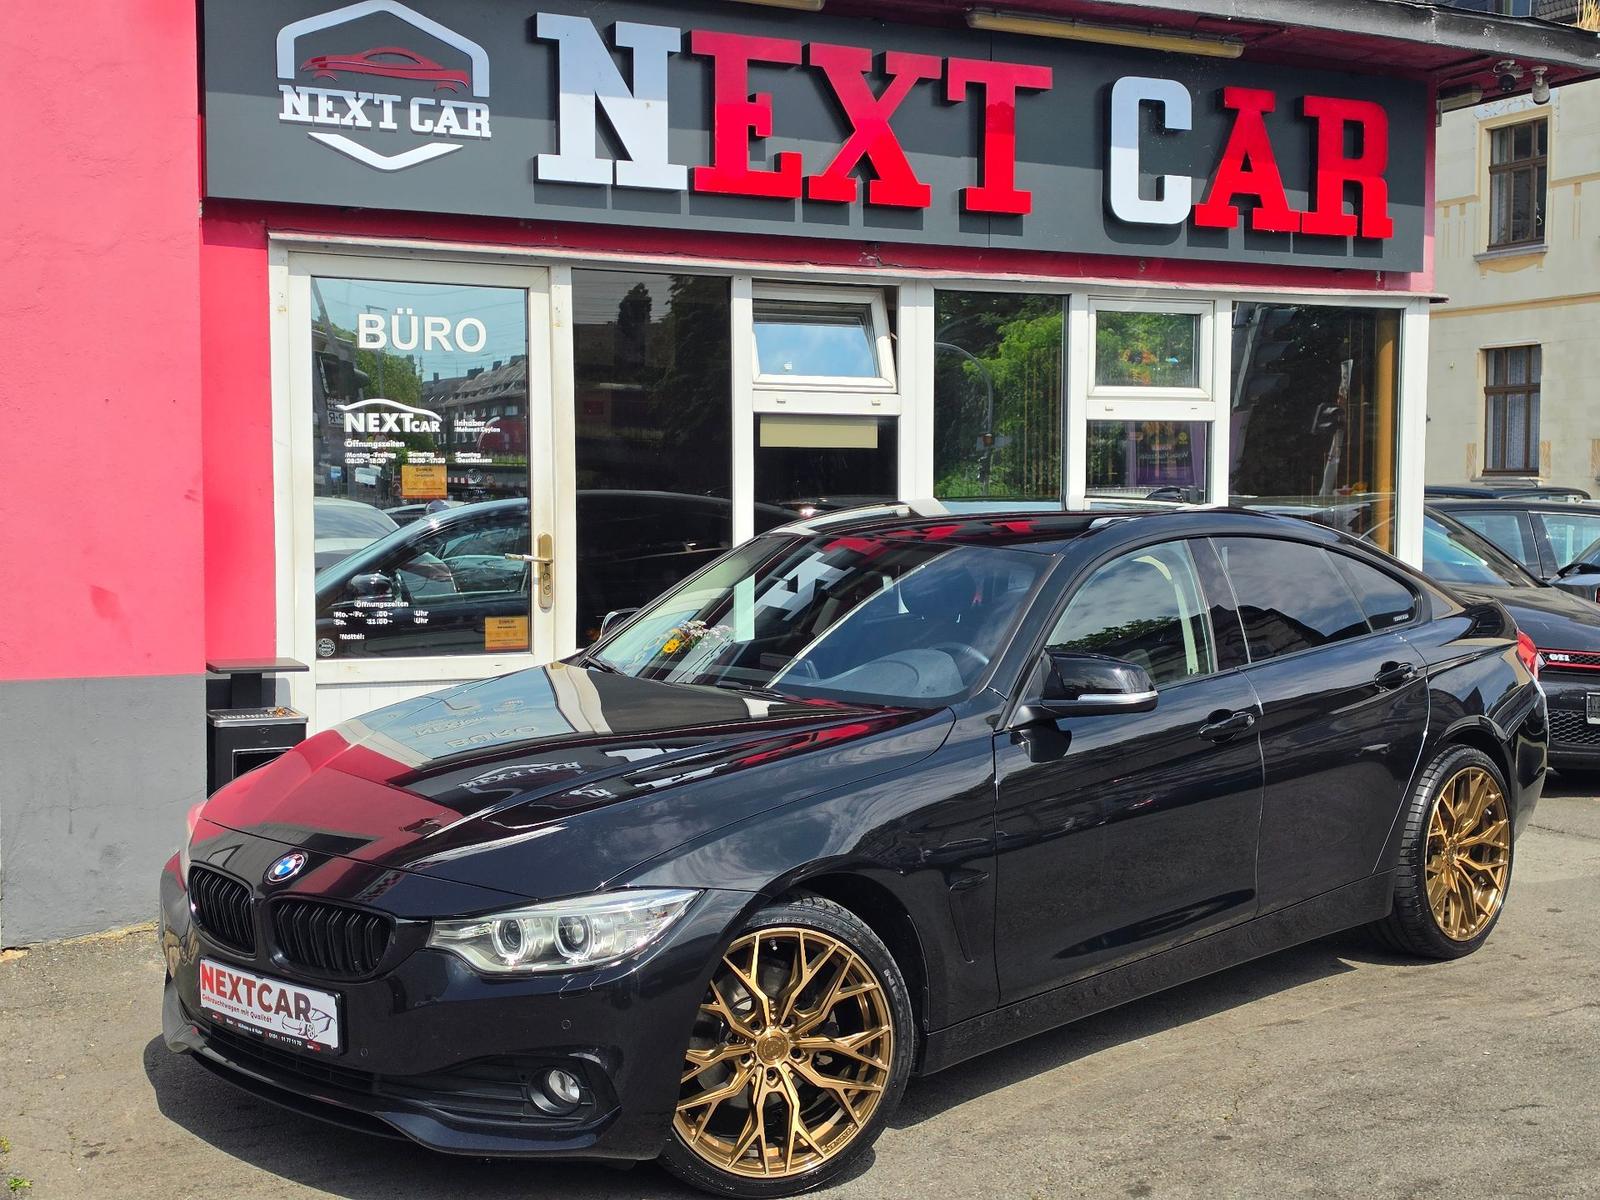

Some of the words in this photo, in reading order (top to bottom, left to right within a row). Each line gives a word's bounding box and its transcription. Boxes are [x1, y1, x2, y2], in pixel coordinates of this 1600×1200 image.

[278, 84, 402, 131] NEXT
[410, 97, 492, 139] CAR
[536, 12, 1053, 215] NEXT
[1109, 76, 1393, 239] CAR
[358, 307, 487, 352] BÜRO
[344, 438, 405, 449] Öffnungszeiten
[354, 600, 409, 609] Öffnungszeiten
[200, 963, 313, 1023] NEXTCAR
